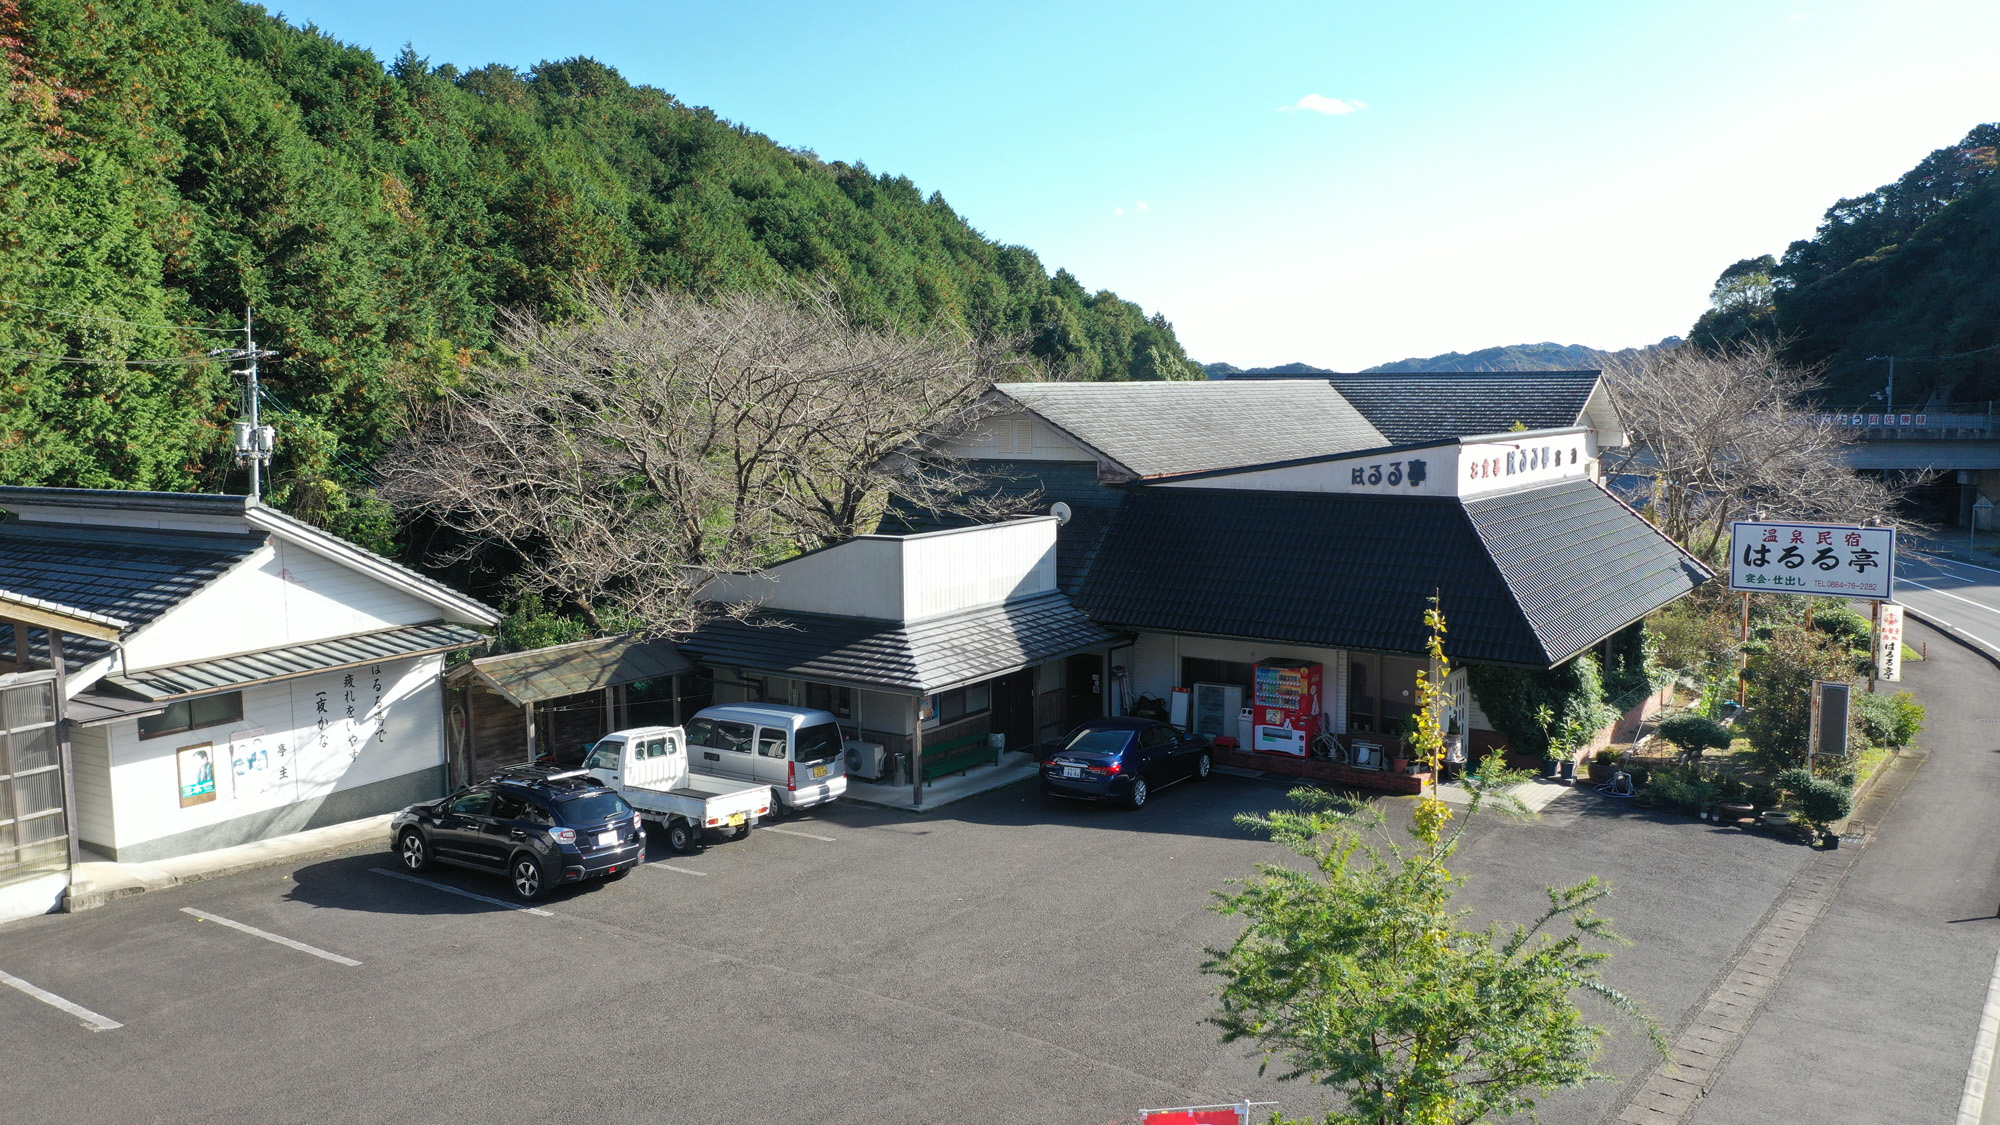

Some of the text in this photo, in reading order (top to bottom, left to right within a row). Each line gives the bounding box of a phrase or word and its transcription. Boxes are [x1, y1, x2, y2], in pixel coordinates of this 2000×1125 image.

[1351, 459, 1427, 487] はるる亭
[1762, 528, 1862, 547] 温泉民宿
[1743, 543, 1879, 573] はるる亭
[1814, 580, 1878, 591] TEL 0884-76-2282
[1883, 642, 1895, 680] はるる亭
[314, 690, 329, 748] 一夜かな
[343, 673, 359, 763] 疲れをいやす
[371, 664, 388, 743] はるる湯で
[277, 743, 289, 780] 亭主
